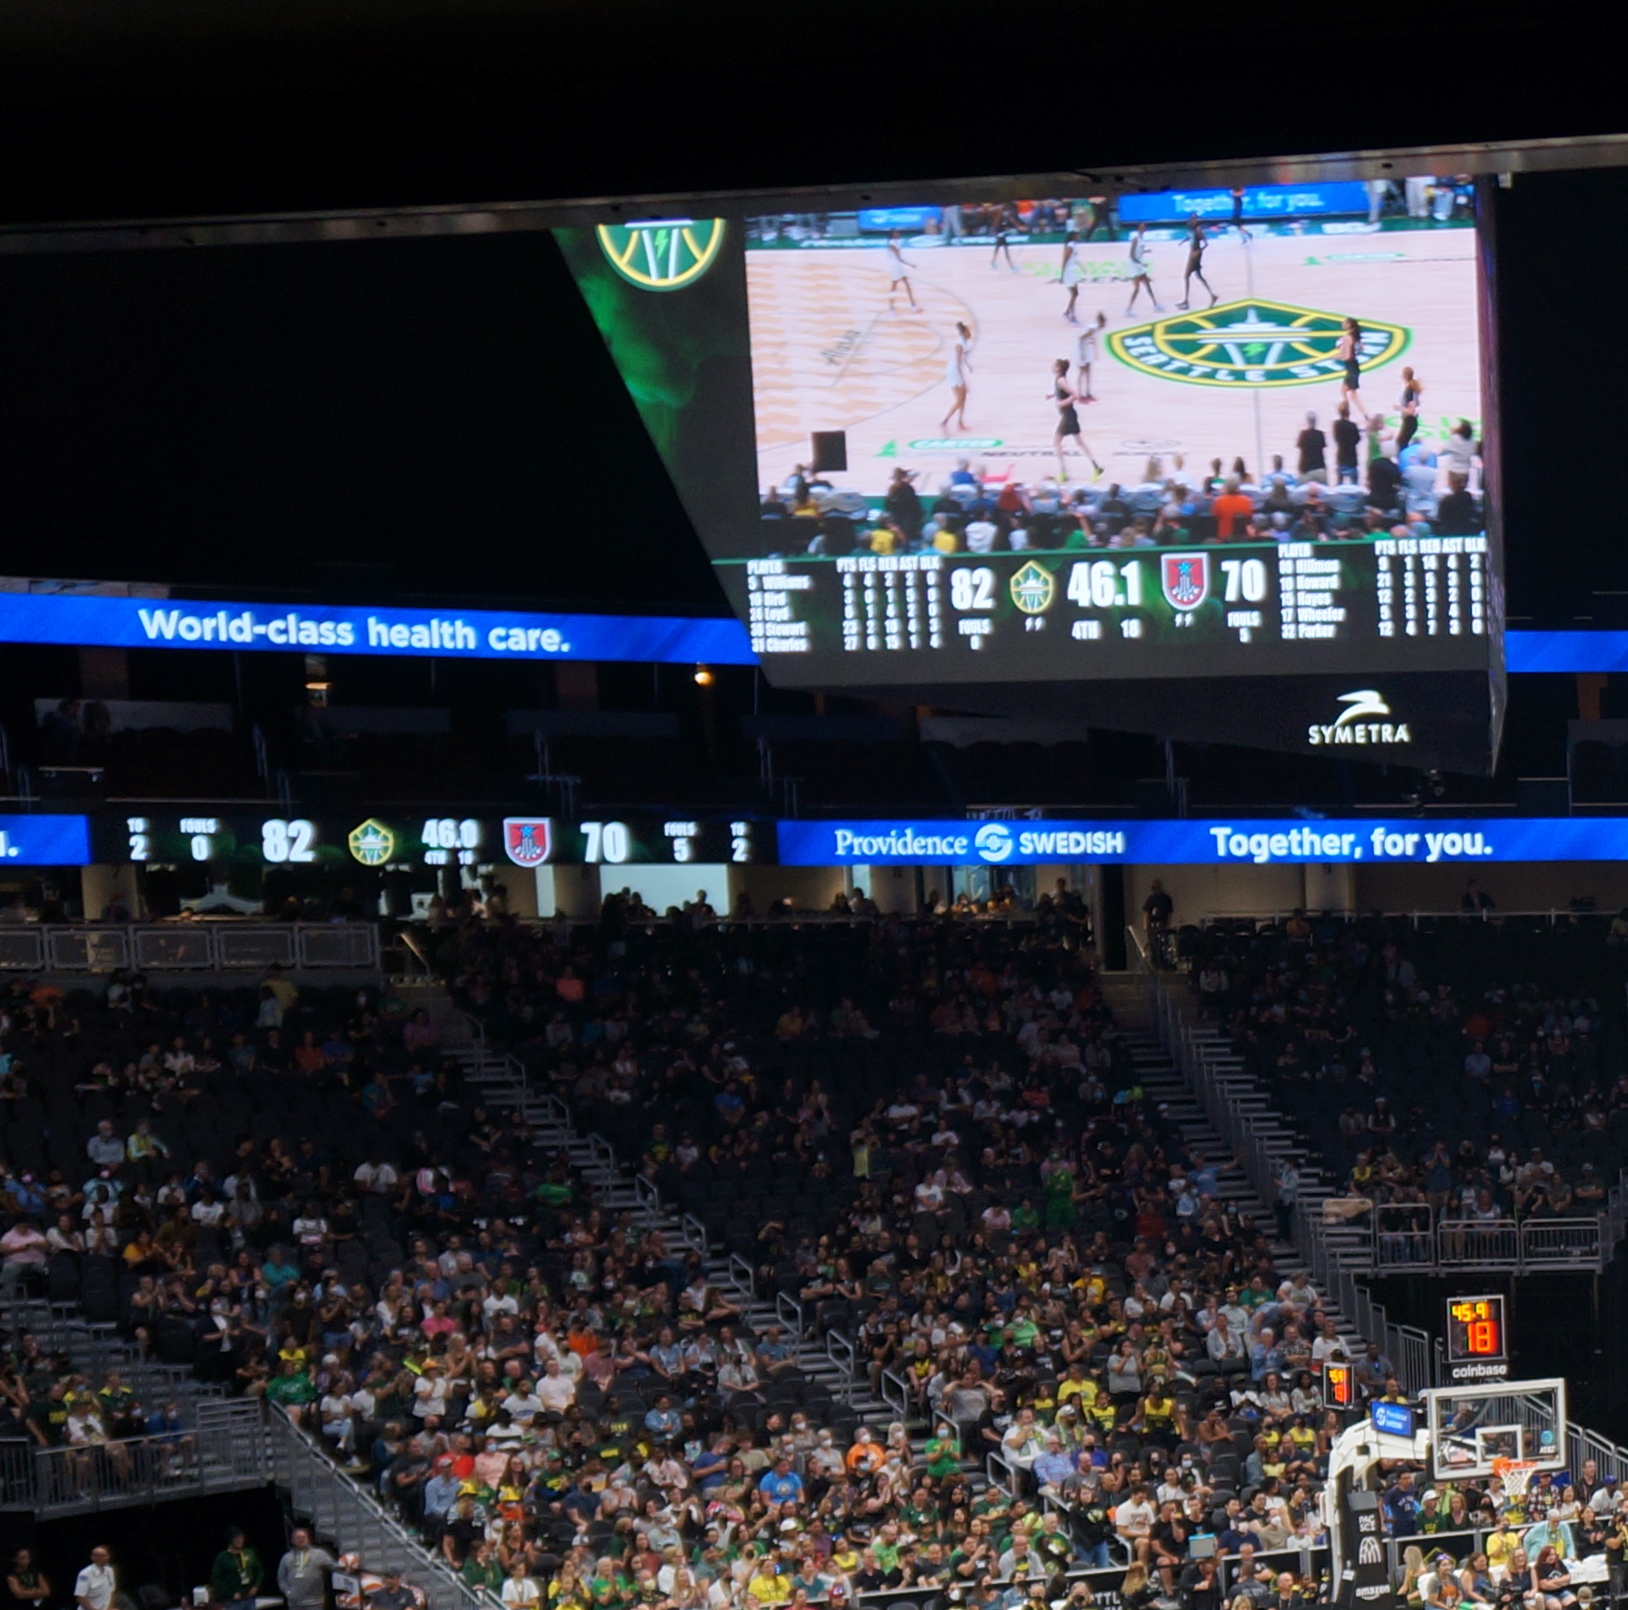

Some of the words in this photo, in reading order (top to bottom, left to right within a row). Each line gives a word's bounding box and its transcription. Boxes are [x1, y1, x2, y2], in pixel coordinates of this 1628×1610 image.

[951, 568, 995, 610] 82
[1067, 561, 1142, 607] 46.1
[1221, 560, 1266, 601] 70
[138, 610, 354, 645] World-class
[368, 617, 476, 649] health
[489, 628, 569, 652] care.
[1072, 621, 1101, 639] 4TH
[1121, 619, 1142, 638] 18
[1309, 718, 1410, 744] SYMETRA
[180, 818, 218, 833] FOULS
[422, 819, 480, 848] 46.0
[664, 822, 697, 836] FOULS
[129, 835, 148, 860] 2
[191, 835, 211, 860] 0
[262, 820, 315, 862] 82
[580, 822, 630, 863] 70
[674, 838, 691, 861] 5
[732, 838, 748, 861] 2
[835, 829, 968, 855] Providence
[1020, 832, 1124, 854] SWEDISH
[1210, 827, 1362, 863] Together,
[1371, 828, 1420, 856] for
[1425, 833, 1492, 862] you.
[1451, 1302, 1490, 1322] 45.9
[1467, 1321, 1497, 1353] 18
[1452, 1363, 1507, 1379] coinbase
[1355, 1584, 1390, 1598] amazon
